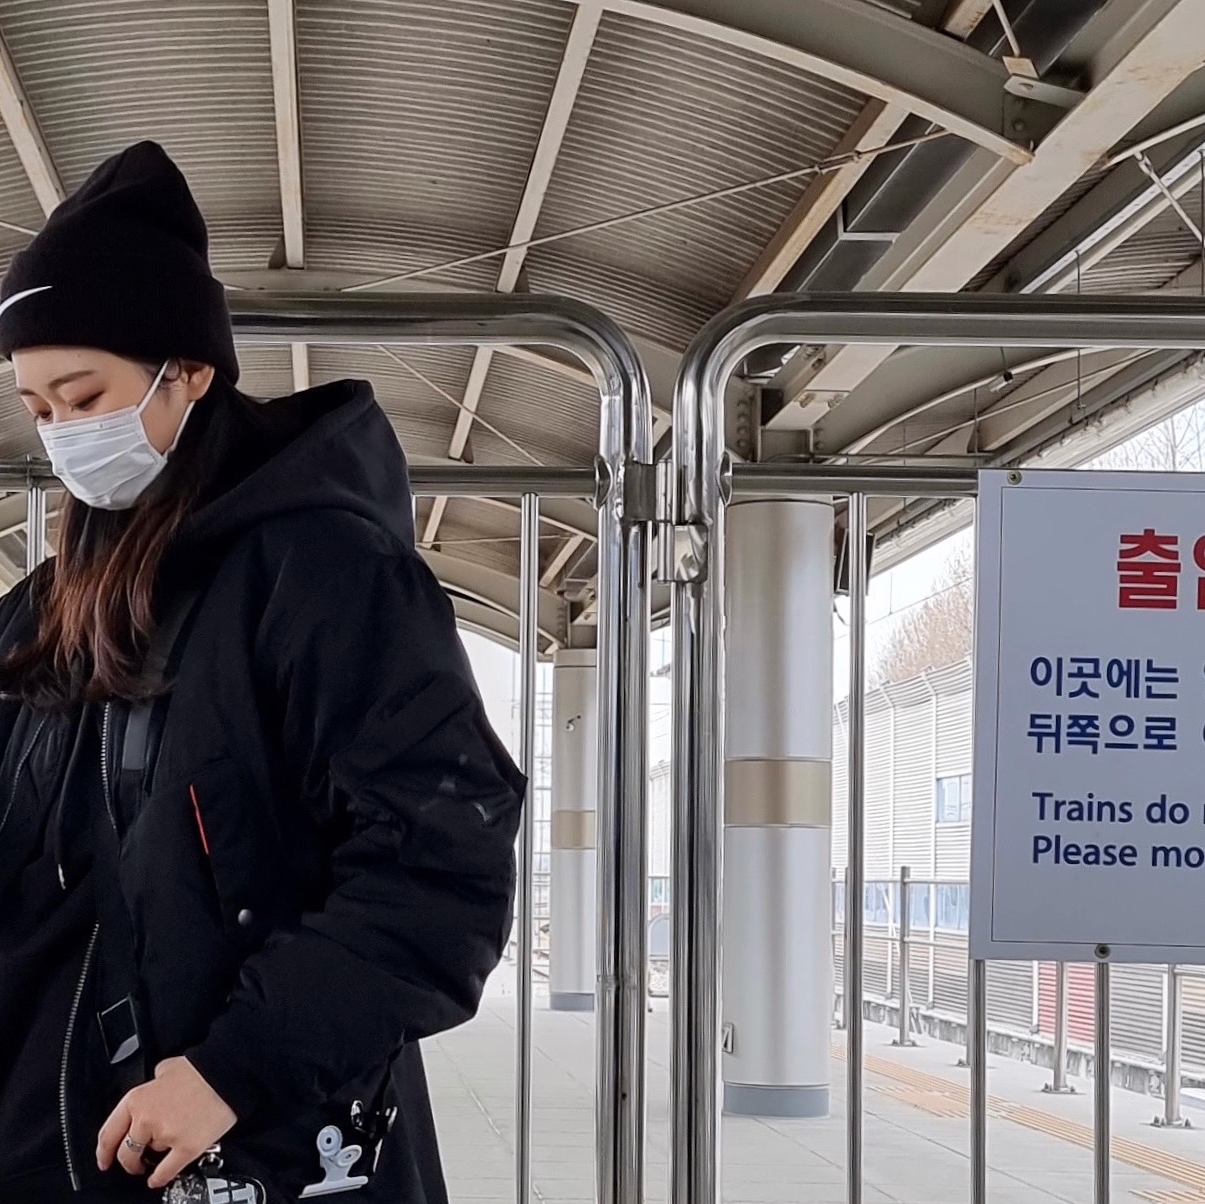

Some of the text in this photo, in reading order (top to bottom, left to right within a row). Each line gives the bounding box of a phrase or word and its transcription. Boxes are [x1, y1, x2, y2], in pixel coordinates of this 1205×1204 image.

[1116, 528, 1205, 610] 출
[1030, 656, 1180, 700] 이곳에는
[1027, 713, 1178, 754] 뒤쪽으로
[1032, 792, 1133, 823] Trains
[1146, 794, 1190, 824] do
[1033, 835, 1138, 867] Please
